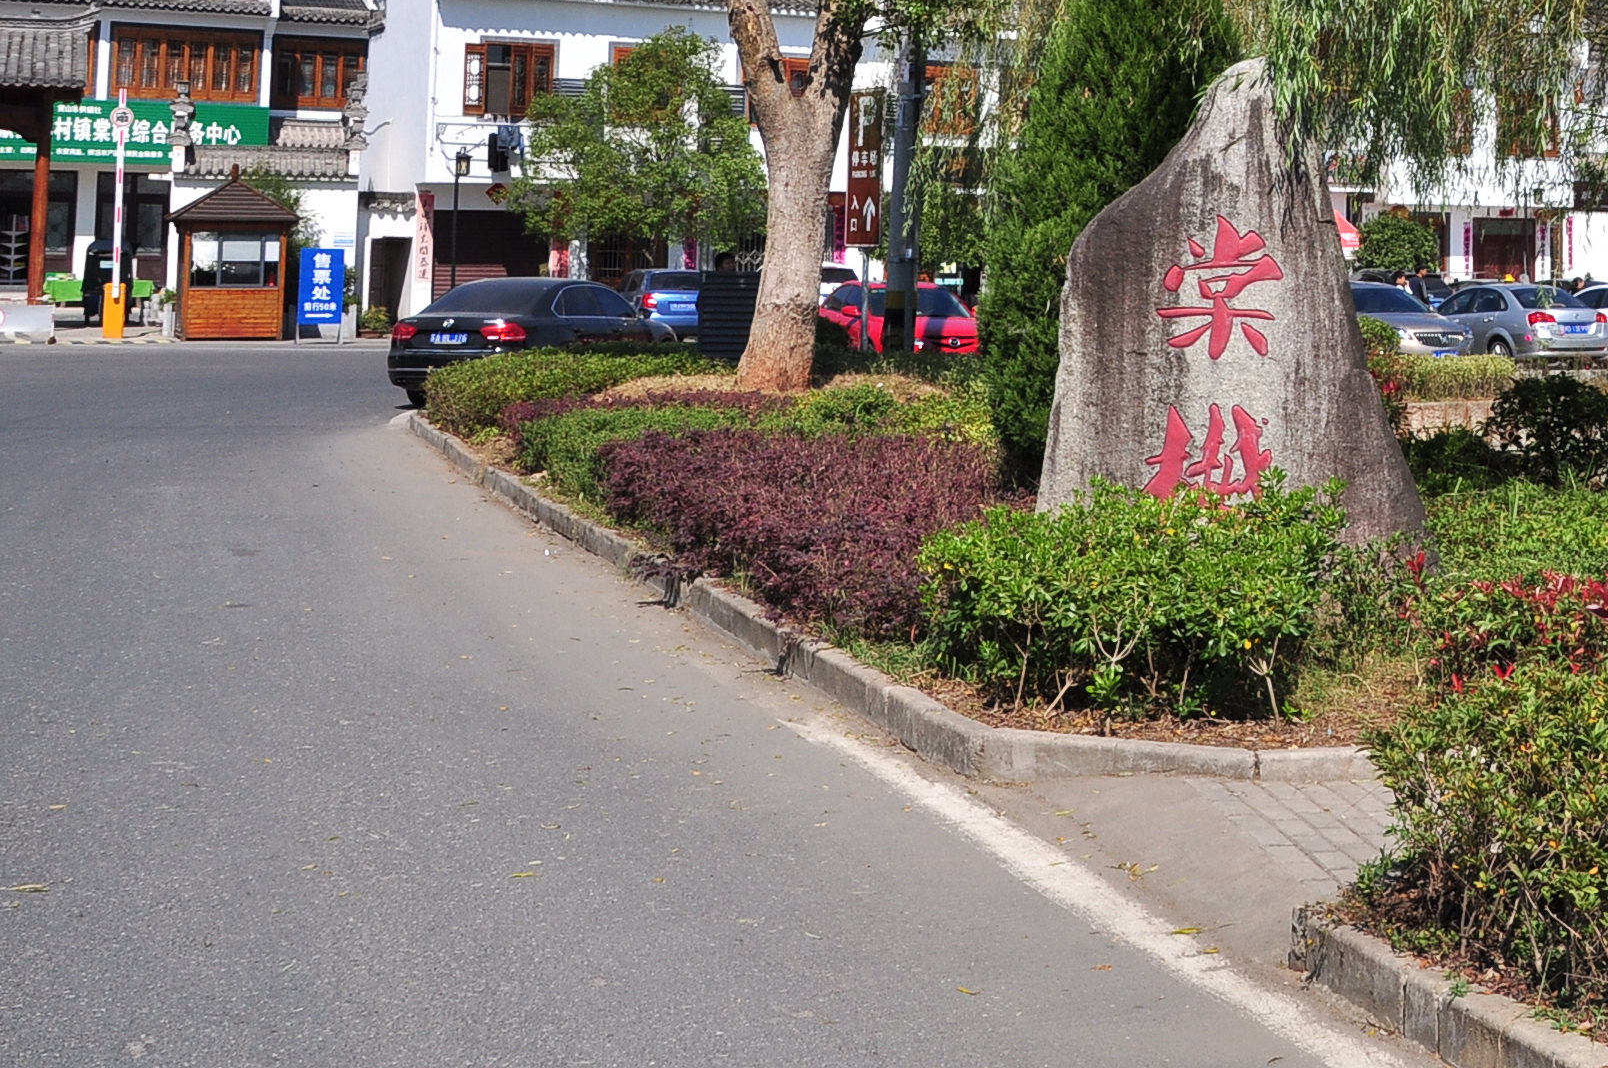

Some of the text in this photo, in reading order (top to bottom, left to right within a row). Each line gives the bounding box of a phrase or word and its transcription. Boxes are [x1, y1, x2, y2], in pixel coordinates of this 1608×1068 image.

[53, 116, 242, 145] 村镇棠综合务中心
[858, 95, 878, 147] P
[851, 150, 878, 167] 停车场
[850, 195, 860, 232] 入口
[312, 252, 333, 301] 售票处
